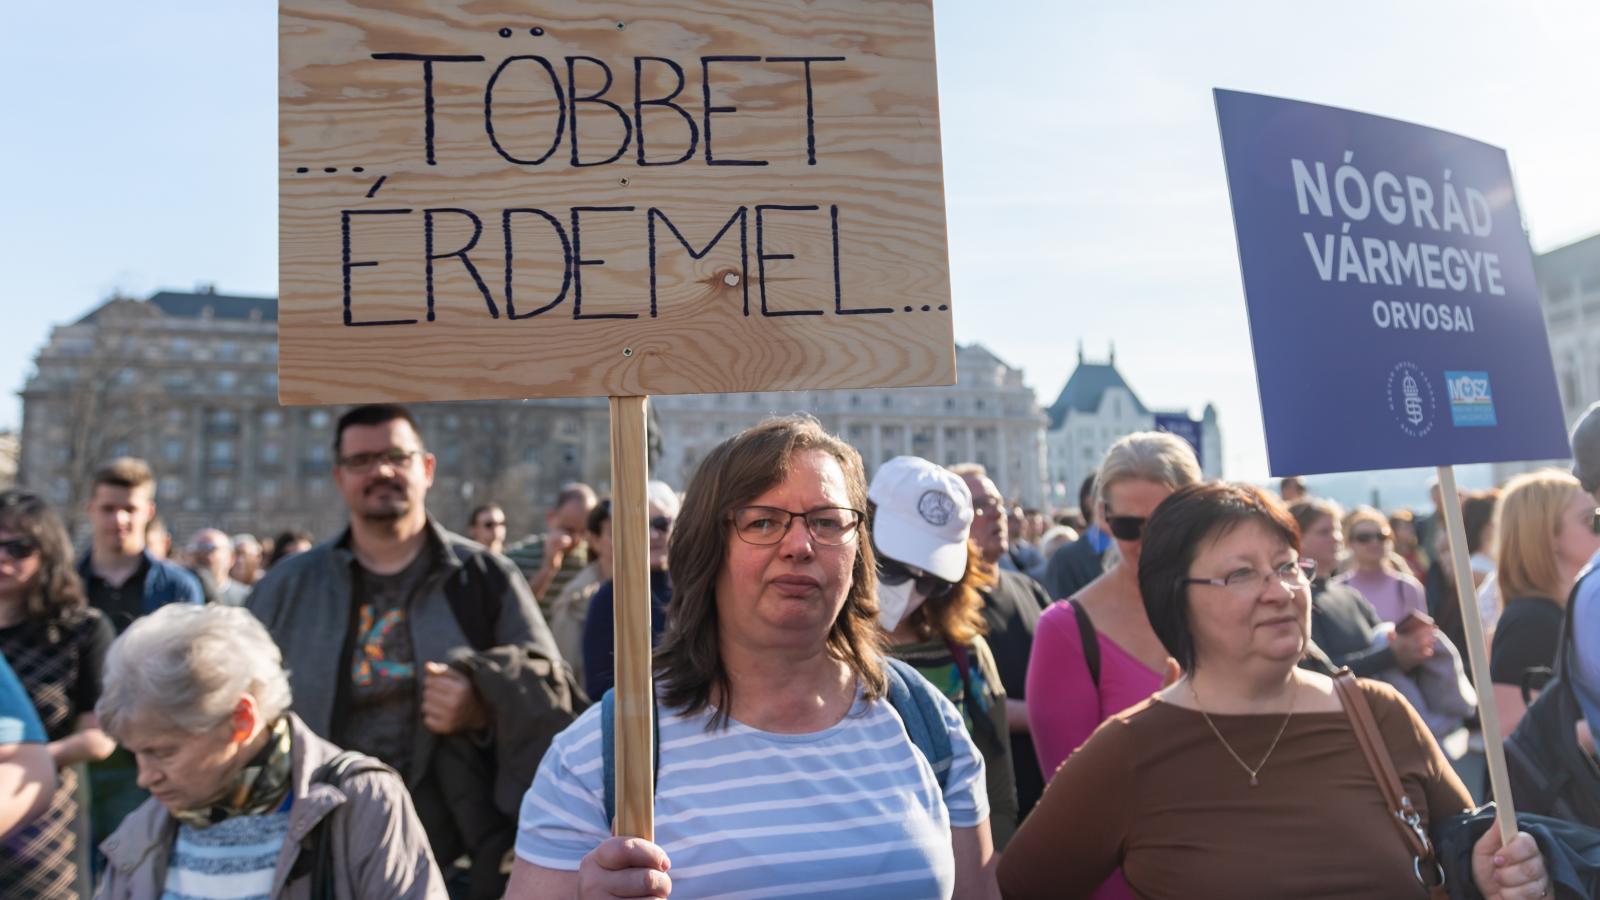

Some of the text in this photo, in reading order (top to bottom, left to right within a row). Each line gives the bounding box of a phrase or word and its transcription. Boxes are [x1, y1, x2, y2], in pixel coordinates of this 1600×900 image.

[1290, 150, 1494, 238] NÓGRÁD
[1302, 221, 1506, 297] VÁRMEGYE
[1372, 299, 1475, 333] ORVOSAI
